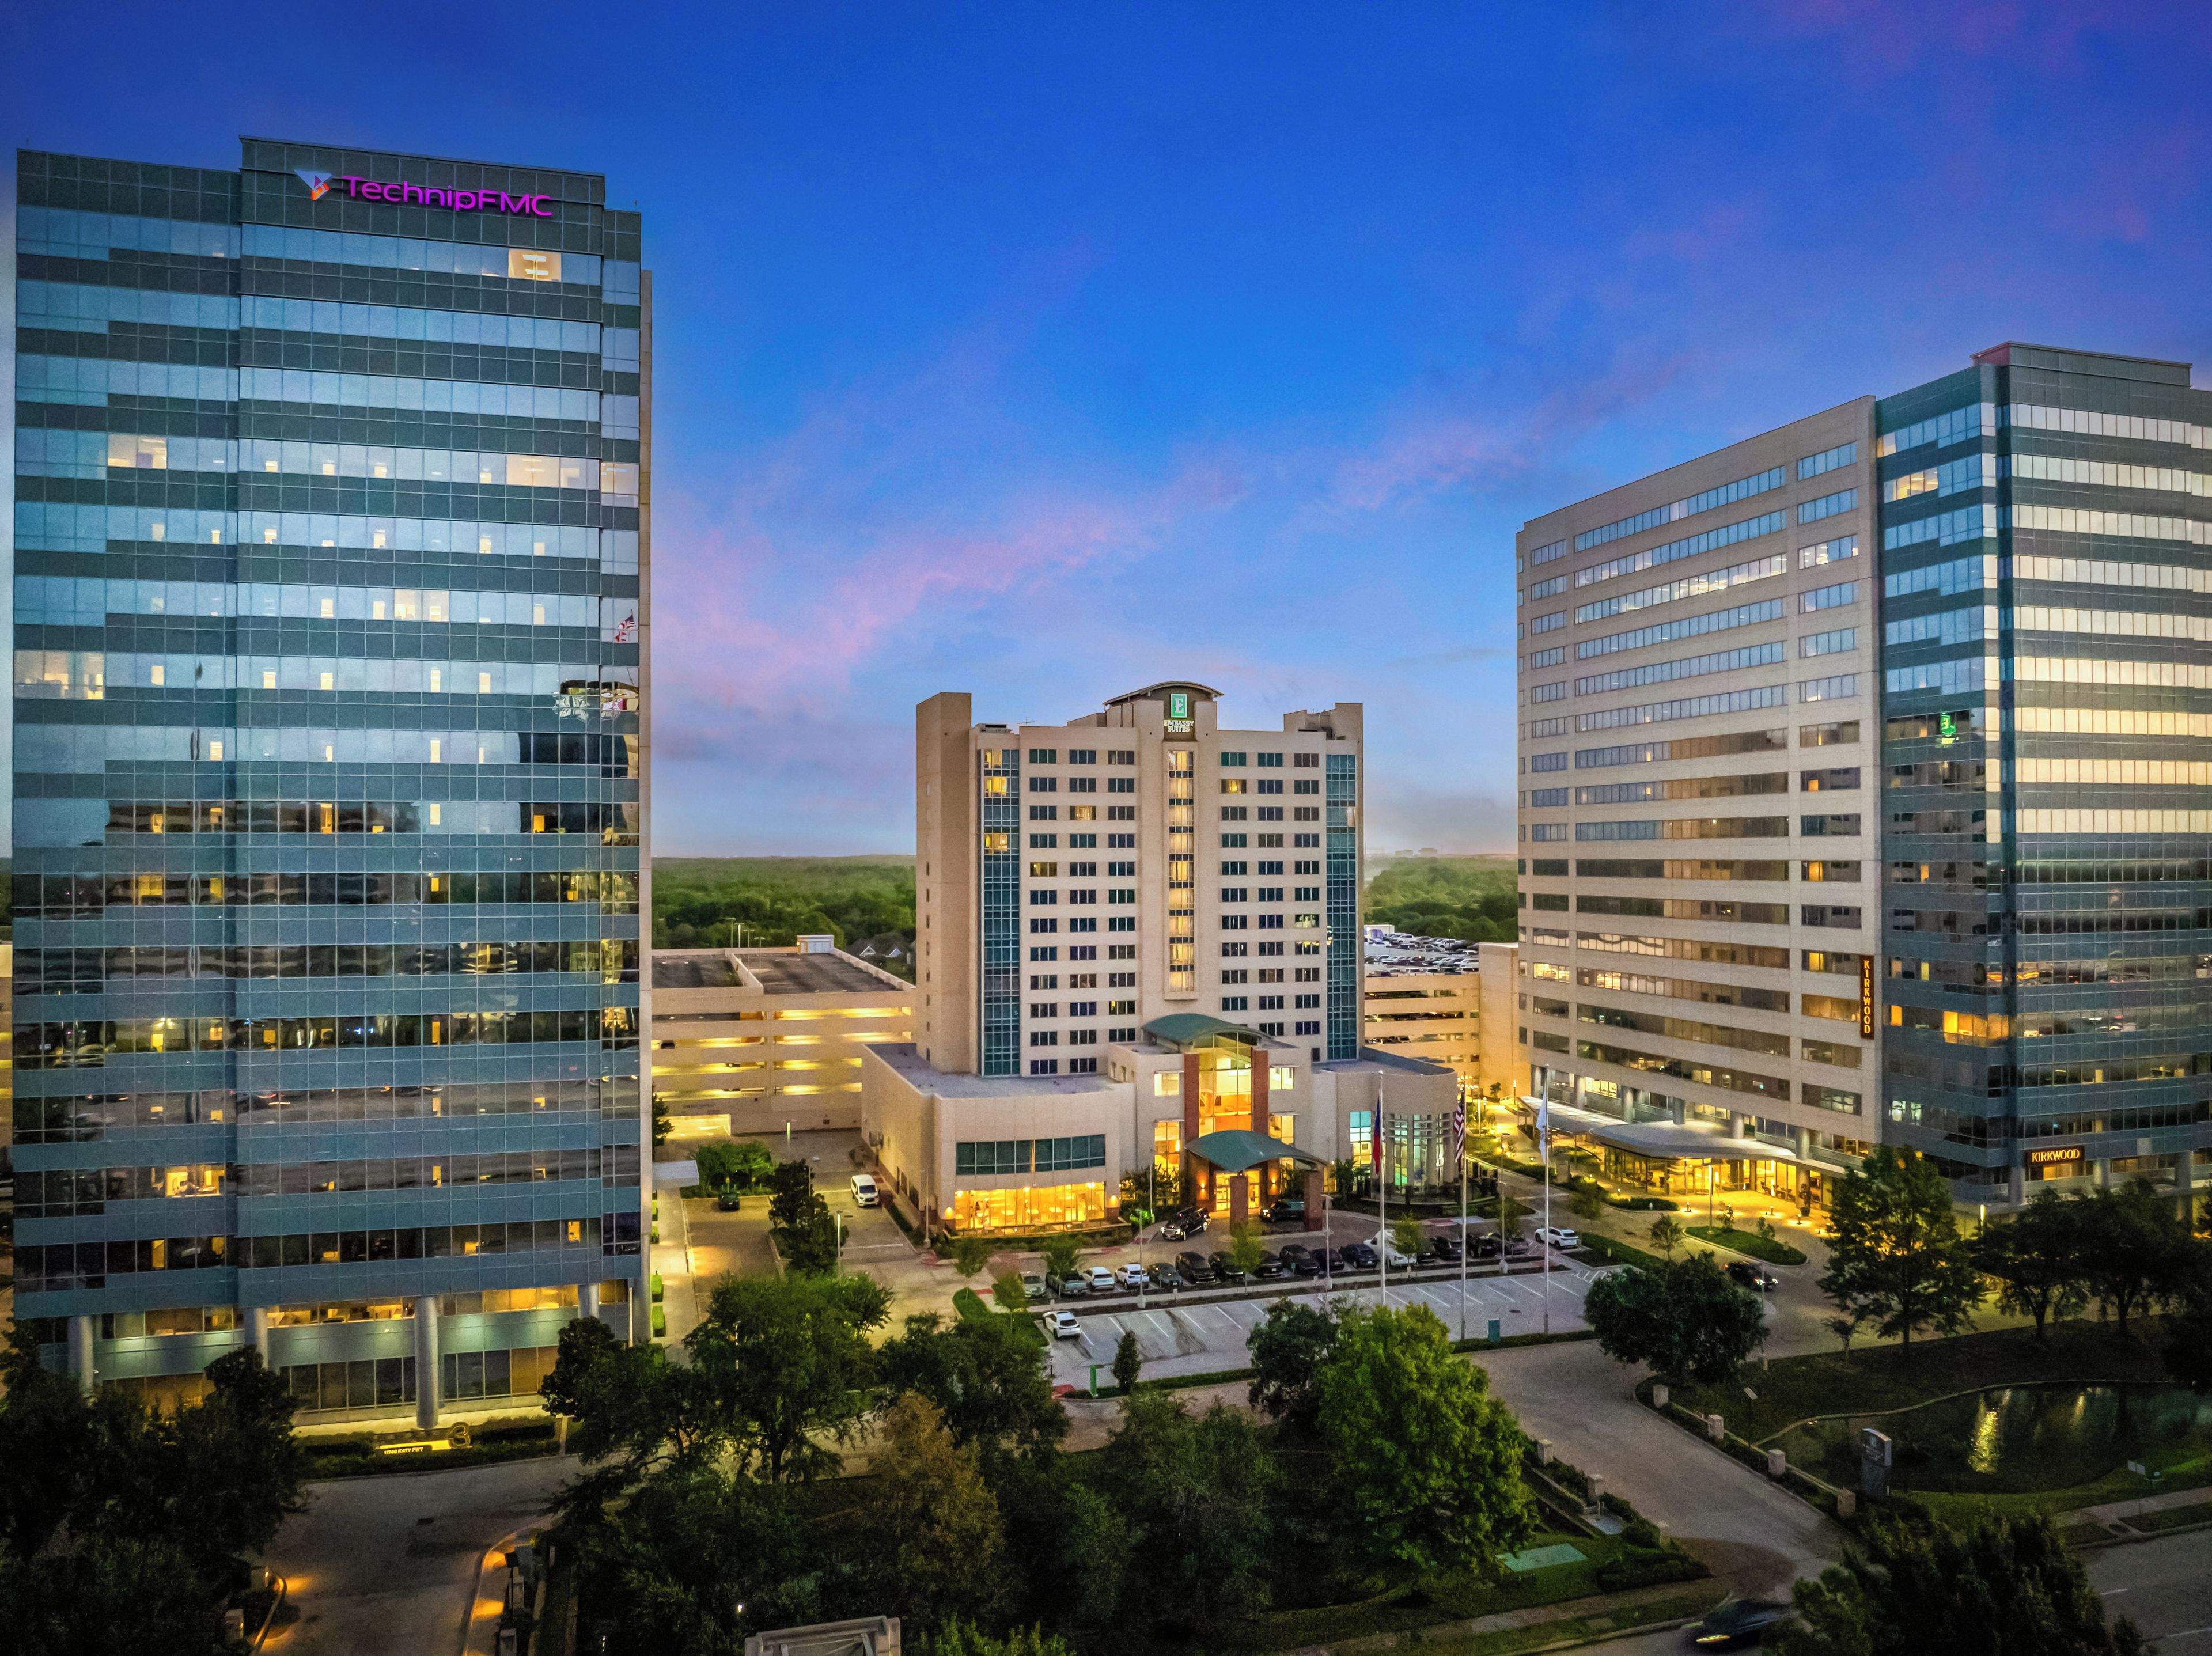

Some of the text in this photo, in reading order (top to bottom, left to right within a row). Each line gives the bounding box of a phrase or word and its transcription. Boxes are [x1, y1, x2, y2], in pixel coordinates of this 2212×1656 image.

[342, 175, 553, 217] TechnipFMC
[1175, 698, 1184, 713] E
[1863, 960, 1871, 1034] KIRKWOOD
[2032, 1149, 2080, 1162] KIRKWOOD
[448, 1422, 471, 1449] 3
